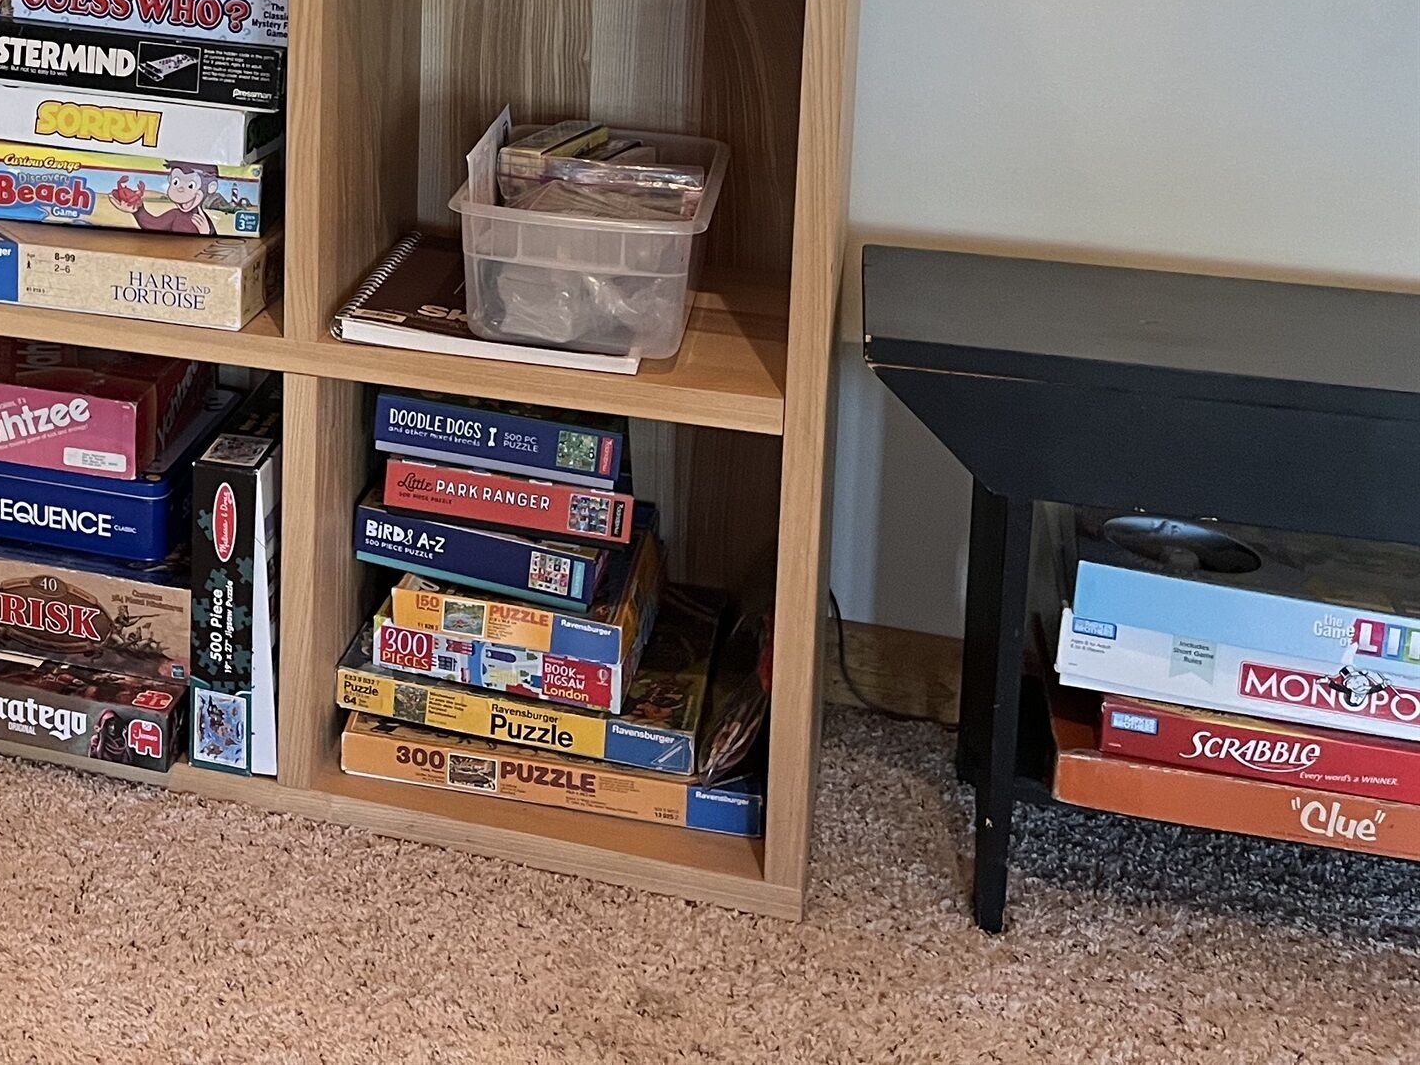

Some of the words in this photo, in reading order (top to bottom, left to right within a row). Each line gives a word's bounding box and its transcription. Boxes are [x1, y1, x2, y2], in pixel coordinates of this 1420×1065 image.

[271, 2, 285, 12] The
[252, 18, 281, 29] Mystery
[35, 100, 162, 147] SORRY!
[4, 154, 43, 168] Curious
[44, 157, 81, 173] George
[19, 173, 71, 184] Discovery
[52, 207, 78, 218] Game
[239, 220, 245, 229] 3
[54, 264, 71, 273] 2-6
[129, 271, 188, 292] HARE
[189, 286, 211, 295] AND
[111, 285, 206, 310] TORTOISE
[389, 408, 444, 432] DOODLE
[446, 418, 482, 439] DOGS
[404, 428, 428, 437] other
[454, 437, 480, 447] breeds
[504, 432, 522, 442] 500
[524, 436, 537, 445] PC
[503, 441, 539, 453] PUZZLE
[398, 472, 434, 492] Little
[435, 480, 478, 499] PARK
[482, 487, 550, 511] RANGER
[365, 538, 380, 547] 500
[381, 542, 403, 553] PIECE
[404, 547, 433, 559] PUZZLE
[417, 532, 446, 553] A-Z
[40, 578, 57, 591] 40
[225, 580, 234, 608] Puzzle
[209, 588, 223, 628] Piece
[415, 594, 440, 609] 150
[489, 605, 549, 626] PUZZLE
[561, 619, 612, 636] Ravensburger
[224, 609, 235, 638] Jigsaw
[1324, 614, 1343, 627] the
[1313, 621, 1355, 639] Game
[209, 631, 223, 662] 500
[385, 628, 427, 657] 300
[382, 651, 429, 669] PIECES
[1193, 650, 1214, 659] Game
[544, 663, 577, 678] BOOK
[343, 681, 379, 697] Puzzle
[544, 674, 586, 690] JIGSAW
[343, 695, 357, 705] 64
[544, 685, 589, 702] London
[491, 704, 558, 724] Ravensburger
[490, 713, 574, 748] Puzzle
[612, 724, 675, 744] Ravensburger
[396, 746, 445, 769] 300
[501, 761, 596, 793] PUZZLE
[1299, 771, 1323, 783] Every
[1325, 774, 1351, 783] word's
[695, 791, 750, 806] Ravensburger
[1290, 797, 1386, 842] "Clue"
